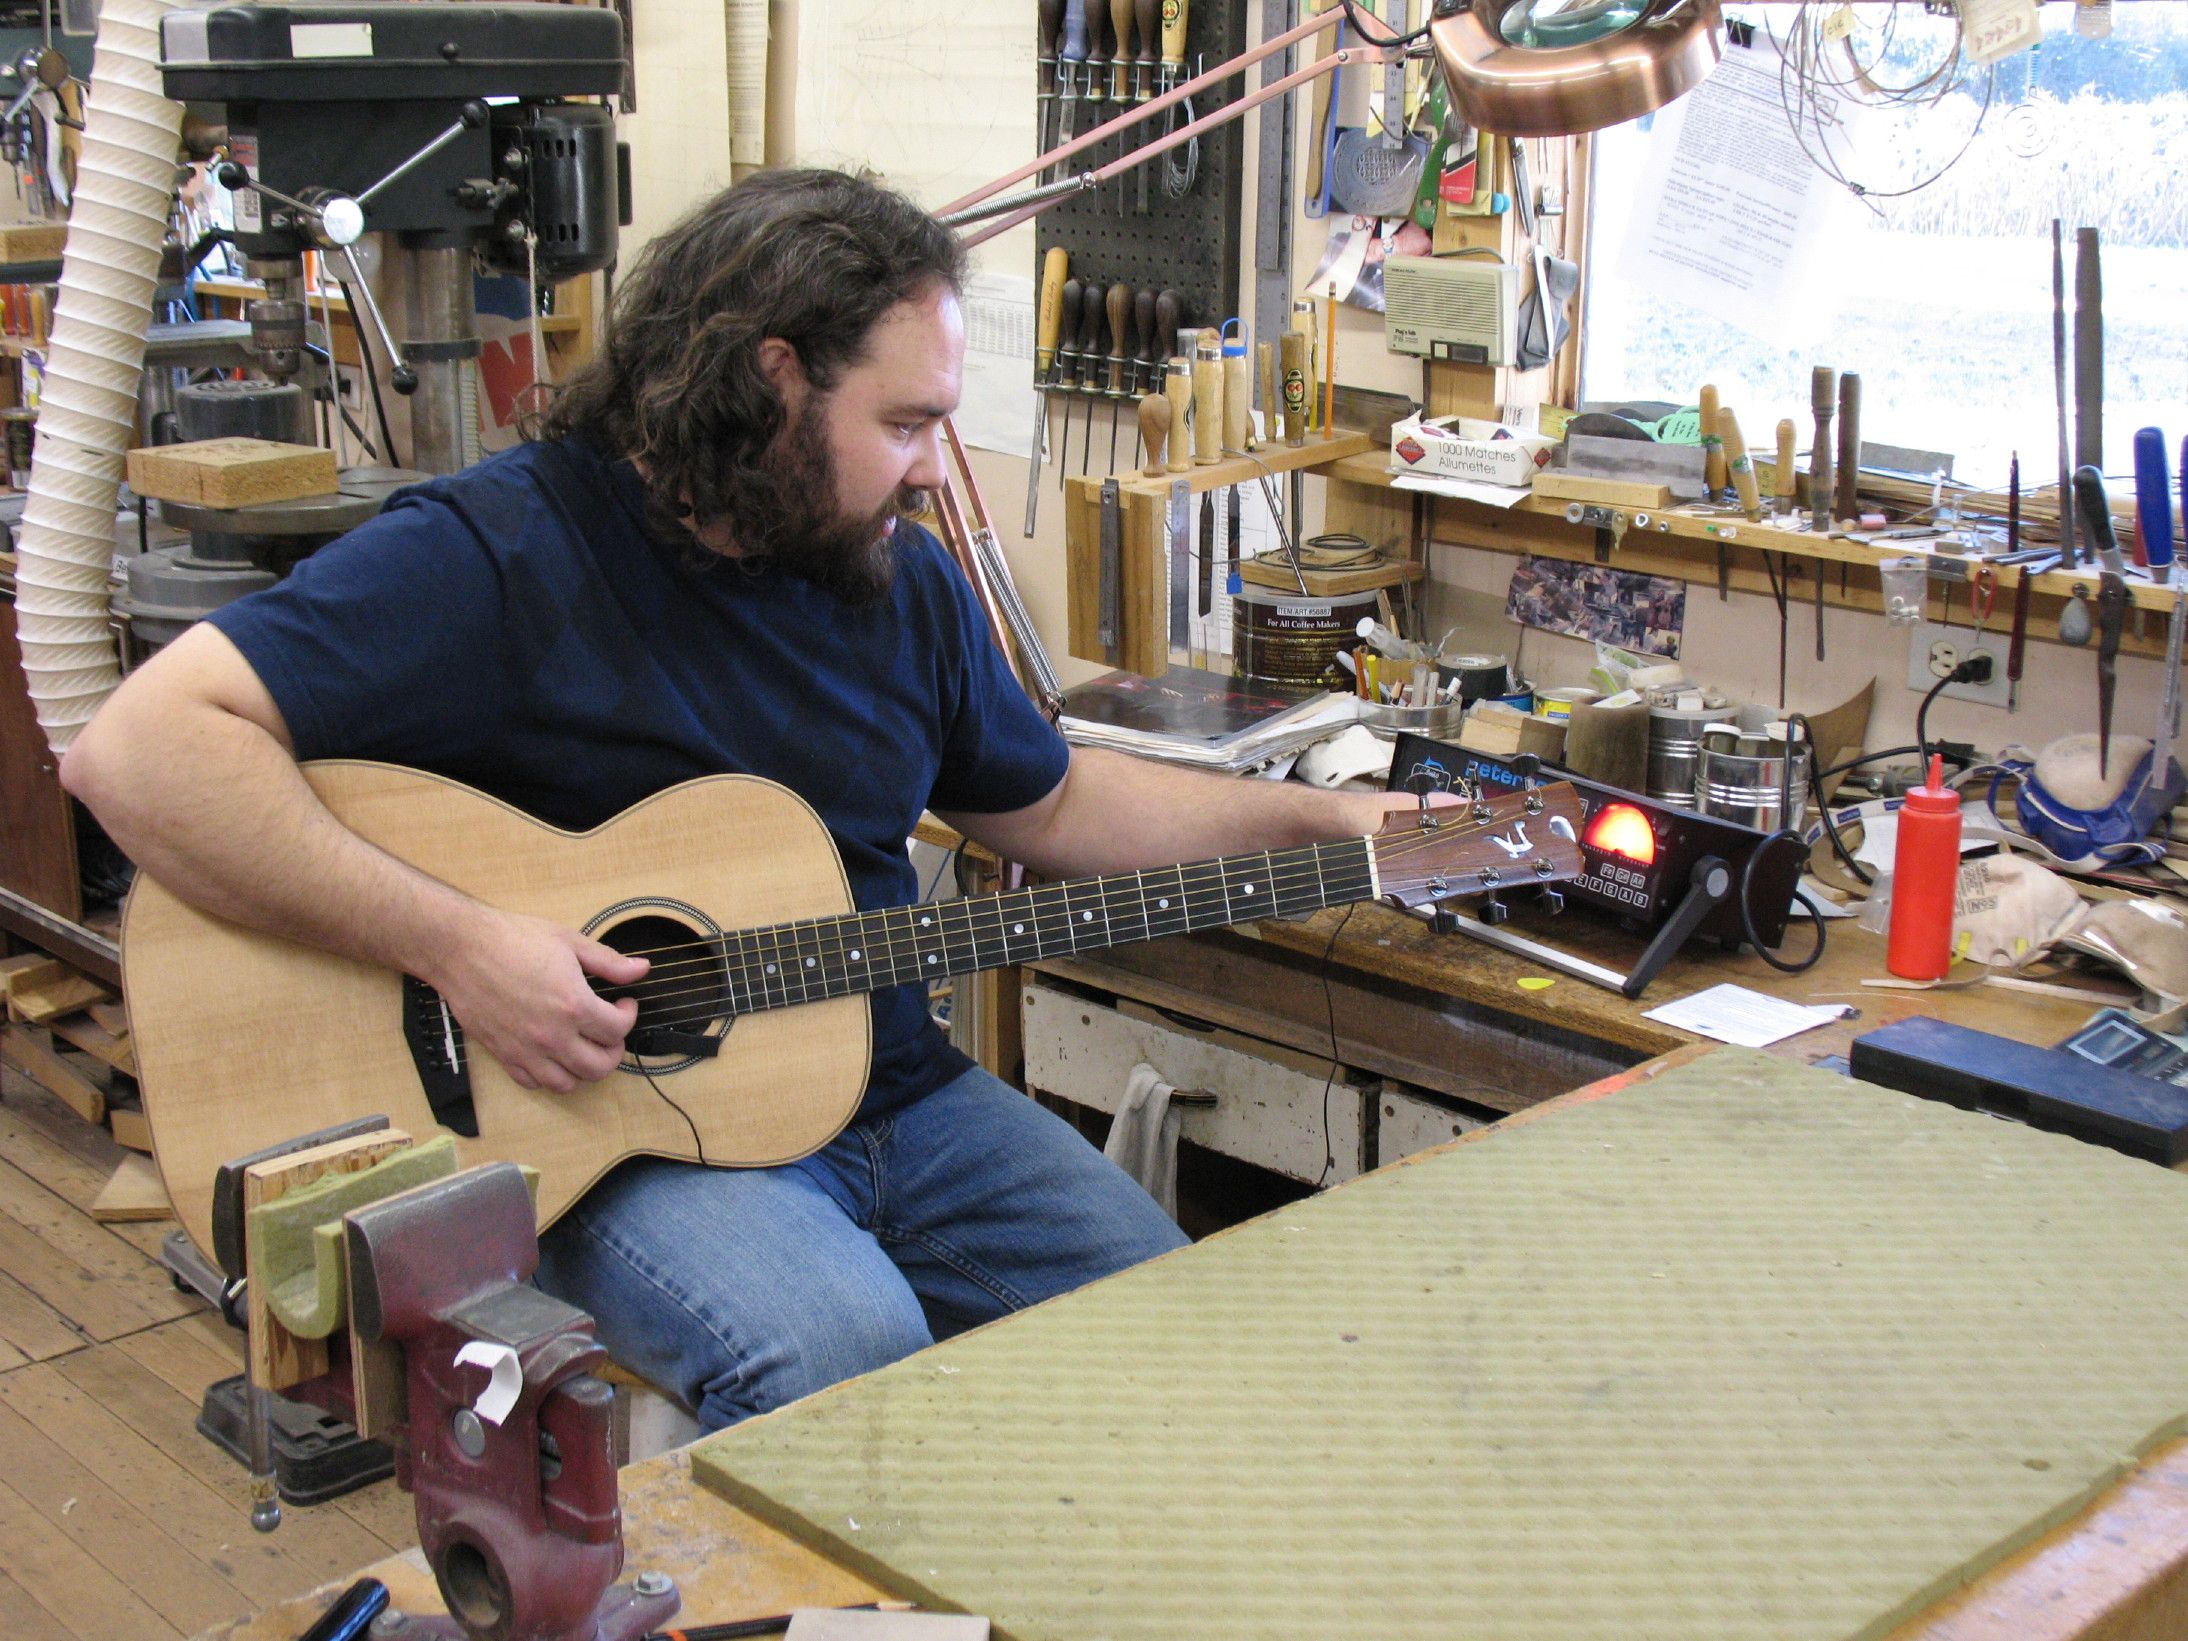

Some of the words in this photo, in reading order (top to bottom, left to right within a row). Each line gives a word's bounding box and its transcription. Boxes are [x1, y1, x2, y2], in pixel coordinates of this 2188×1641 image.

[1439, 442, 1463, 456] 1000
[1465, 445, 1516, 462] Matches
[1438, 456, 1496, 475] Allumettes
[1267, 618, 1279, 627] For
[1280, 619, 1290, 628] All
[1291, 620, 1316, 629] Coffee
[1316, 620, 1341, 629] Makers
